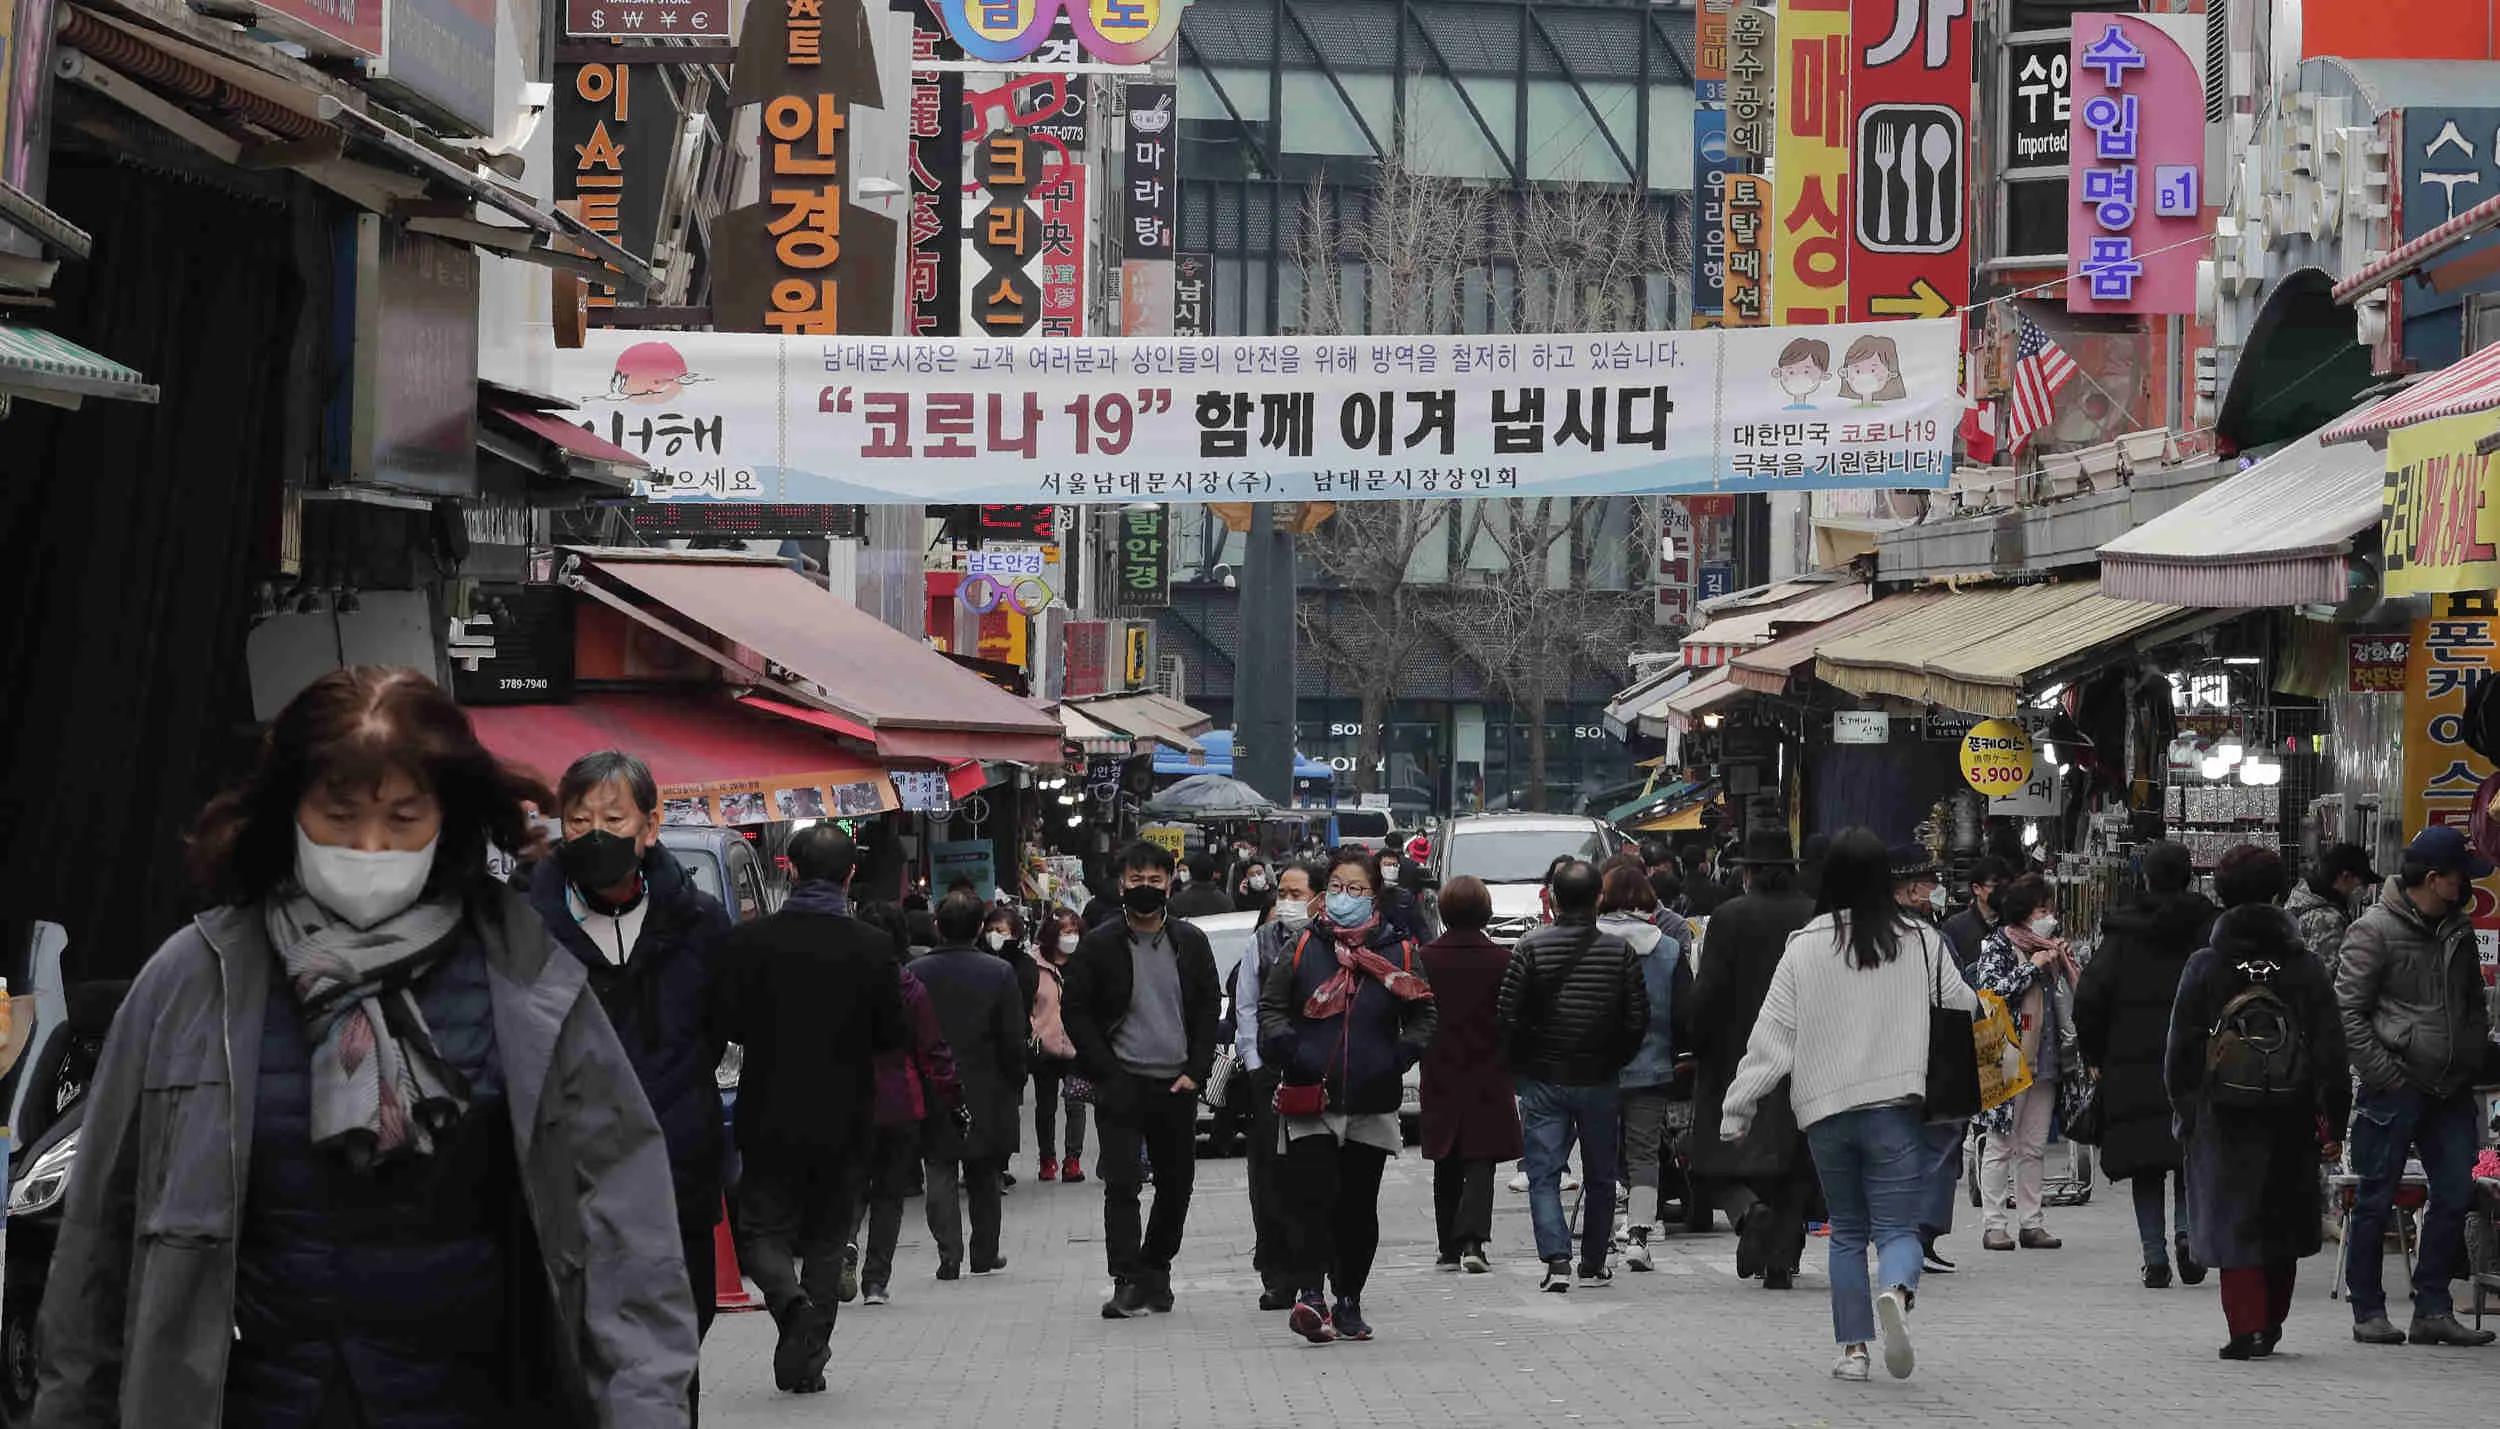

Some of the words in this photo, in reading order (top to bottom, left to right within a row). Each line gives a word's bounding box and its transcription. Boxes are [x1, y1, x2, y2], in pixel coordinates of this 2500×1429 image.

[2018, 131, 2068, 160] Imported
[2079, 24, 2147, 301] 수입명품
[1134, 142, 1165, 246] 마라탕
[2161, 171, 2191, 209] B1
[986, 139, 1026, 324] 크리스
[1730, 181, 1761, 318] 토탈패션
[822, 343, 958, 374] 남대문시장은
[971, 343, 1016, 373] 고객
[1029, 343, 1118, 375] 여러분과
[1131, 344, 1220, 375] 상인들의
[1234, 344, 1301, 374] 안전을
[1315, 345, 1358, 374] 위해
[1372, 344, 1438, 374] 방역을
[1451, 343, 1518, 374] 철저히
[1531, 342, 1575, 371] 하고
[1589, 340, 1686, 371] 있습니다.
[818, 385, 1045, 459] “코로나
[1063, 387, 1173, 457] 19”
[1195, 389, 1314, 458] 함께
[1340, 388, 1458, 457] 이겨
[1491, 384, 1674, 455] 냅시다
[1733, 423, 1831, 447] 대한민국
[1839, 420, 1938, 445] 코로나19
[1731, 450, 1804, 478] 극복을
[1815, 447, 1944, 476] 기원합니다!
[1313, 467, 1519, 494] 남대문시장상인회
[969, 552, 1042, 574] 남도안경
[2351, 641, 2408, 663] 강화유
[499, 678, 548, 690] 3789-7940
[1330, 723, 1384, 736] SO
[1968, 736, 2025, 752] 폰케이스
